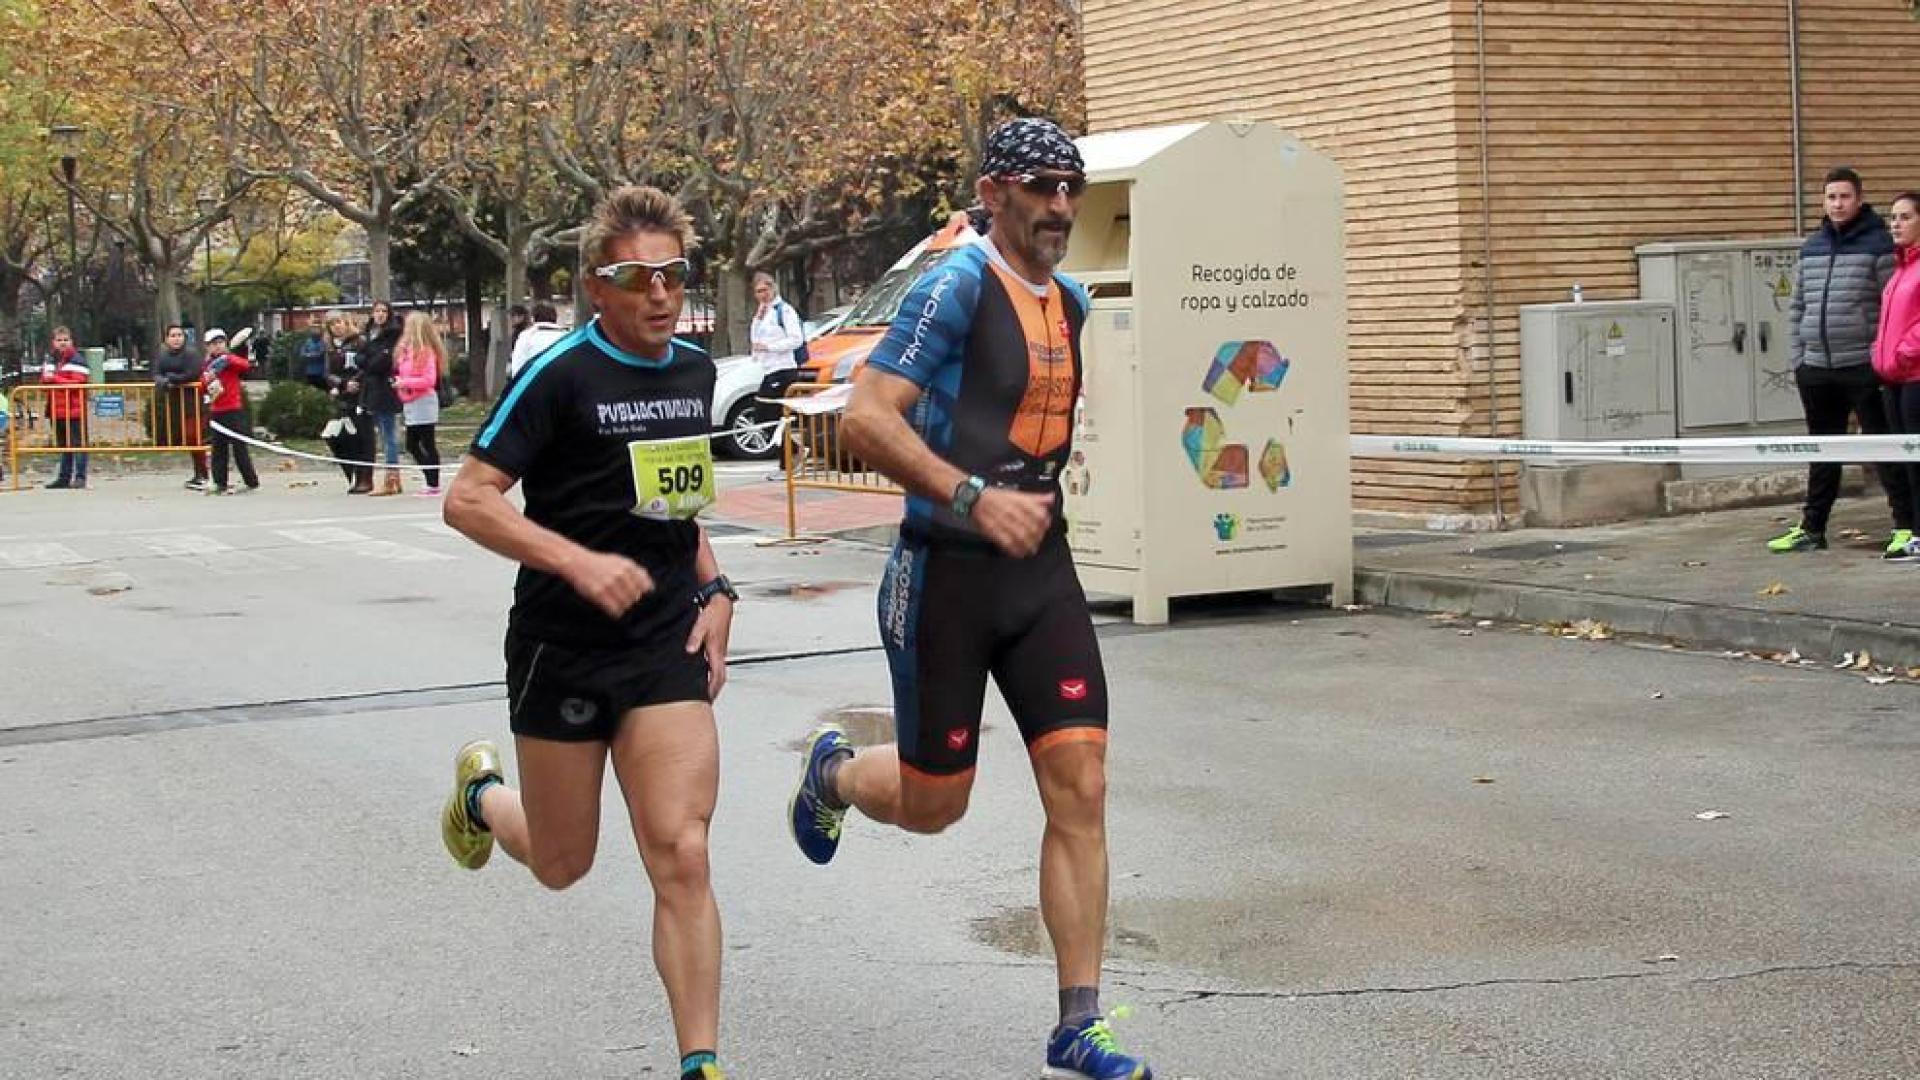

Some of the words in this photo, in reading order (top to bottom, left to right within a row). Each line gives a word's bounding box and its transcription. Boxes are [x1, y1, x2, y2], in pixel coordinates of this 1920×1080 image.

[1192, 263, 1271, 286] Recogida
[1275, 263, 1297, 280] de
[1181, 295, 1221, 314] ropa
[1225, 295, 1238, 313] y
[1241, 288, 1310, 309] calzado
[657, 464, 704, 495] 509
